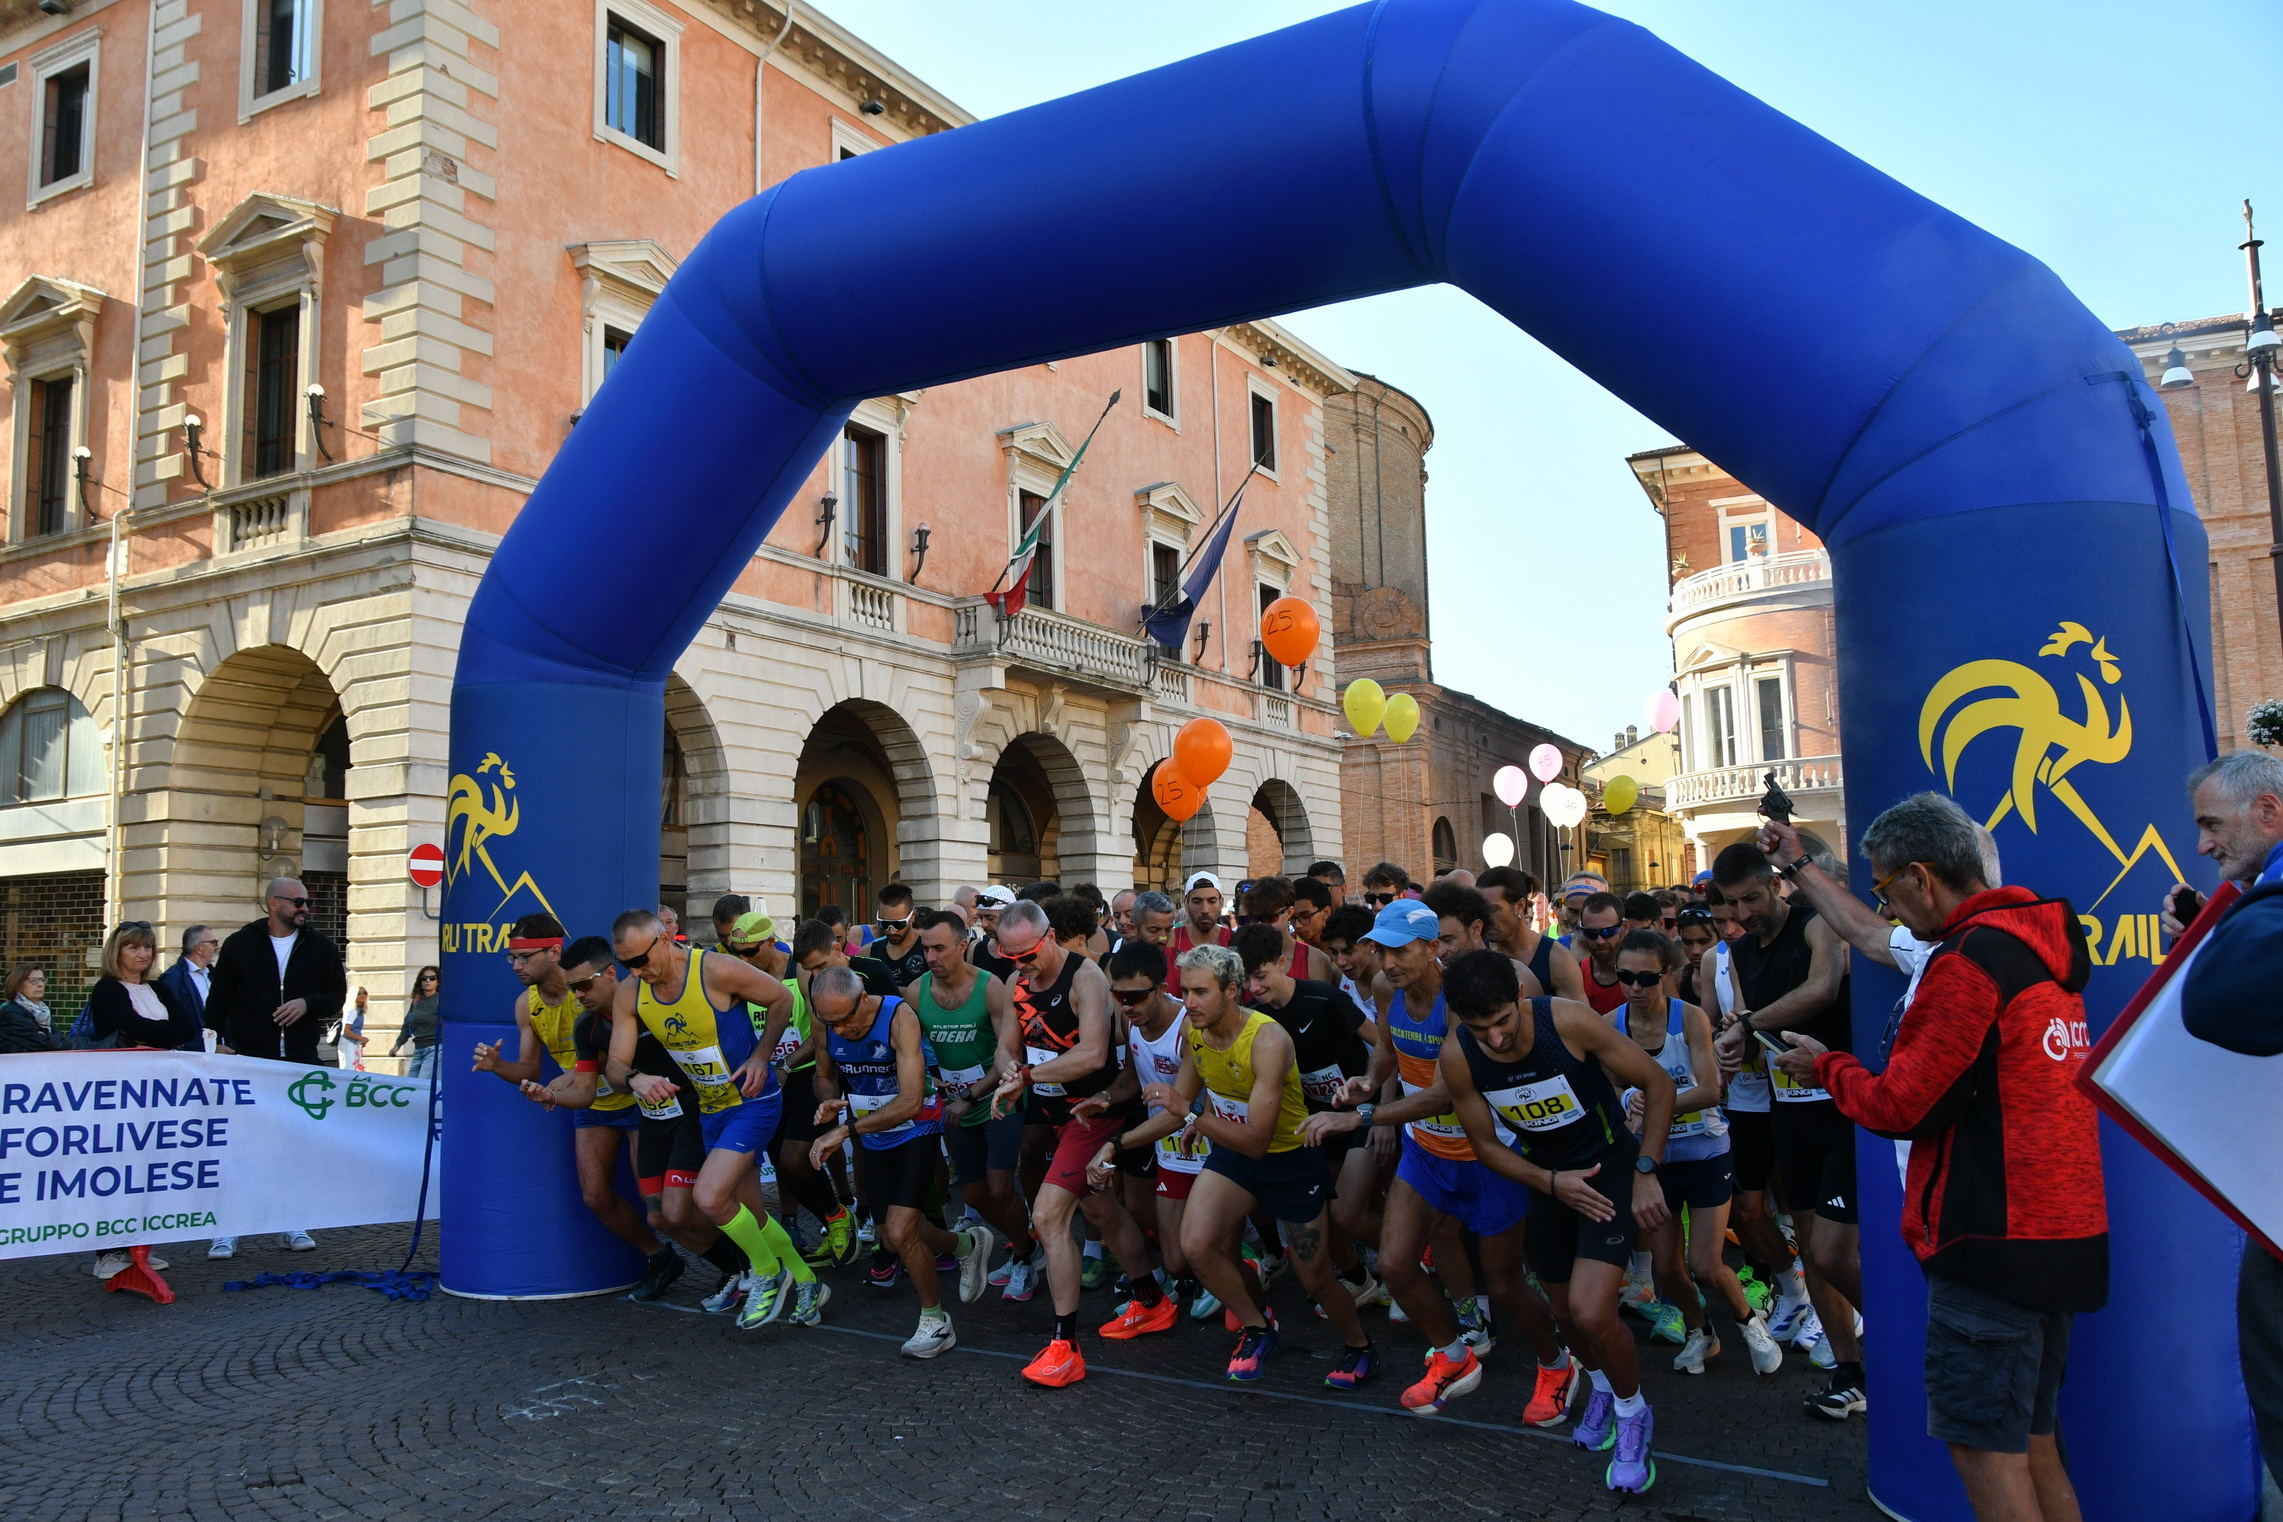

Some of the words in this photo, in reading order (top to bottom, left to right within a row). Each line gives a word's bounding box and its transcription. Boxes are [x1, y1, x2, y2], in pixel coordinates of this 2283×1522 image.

[1266, 609, 1293, 635] 25
[1157, 780, 1183, 805] 25
[1565, 799, 1578, 813] 40
[463, 923, 516, 953] TRA
[2077, 914, 2168, 966] RAIL
[929, 1029, 977, 1043] EDERA
[684, 1062, 713, 1076] 167
[1321, 1071, 1335, 1081] NC
[2, 1078, 256, 1115] RAVENNATE
[346, 1083, 417, 1108] BCC
[1509, 1096, 1565, 1120] 108
[1426, 1122, 1452, 1133] KING
[1524, 1115, 1559, 1128] KING
[0, 1118, 229, 1159] FORLIVESE
[36, 1159, 220, 1201] IMOLESE
[0, 1222, 89, 1246] GRUPPO
[96, 1217, 137, 1236] BCC
[142, 1211, 217, 1232] ICCREA
